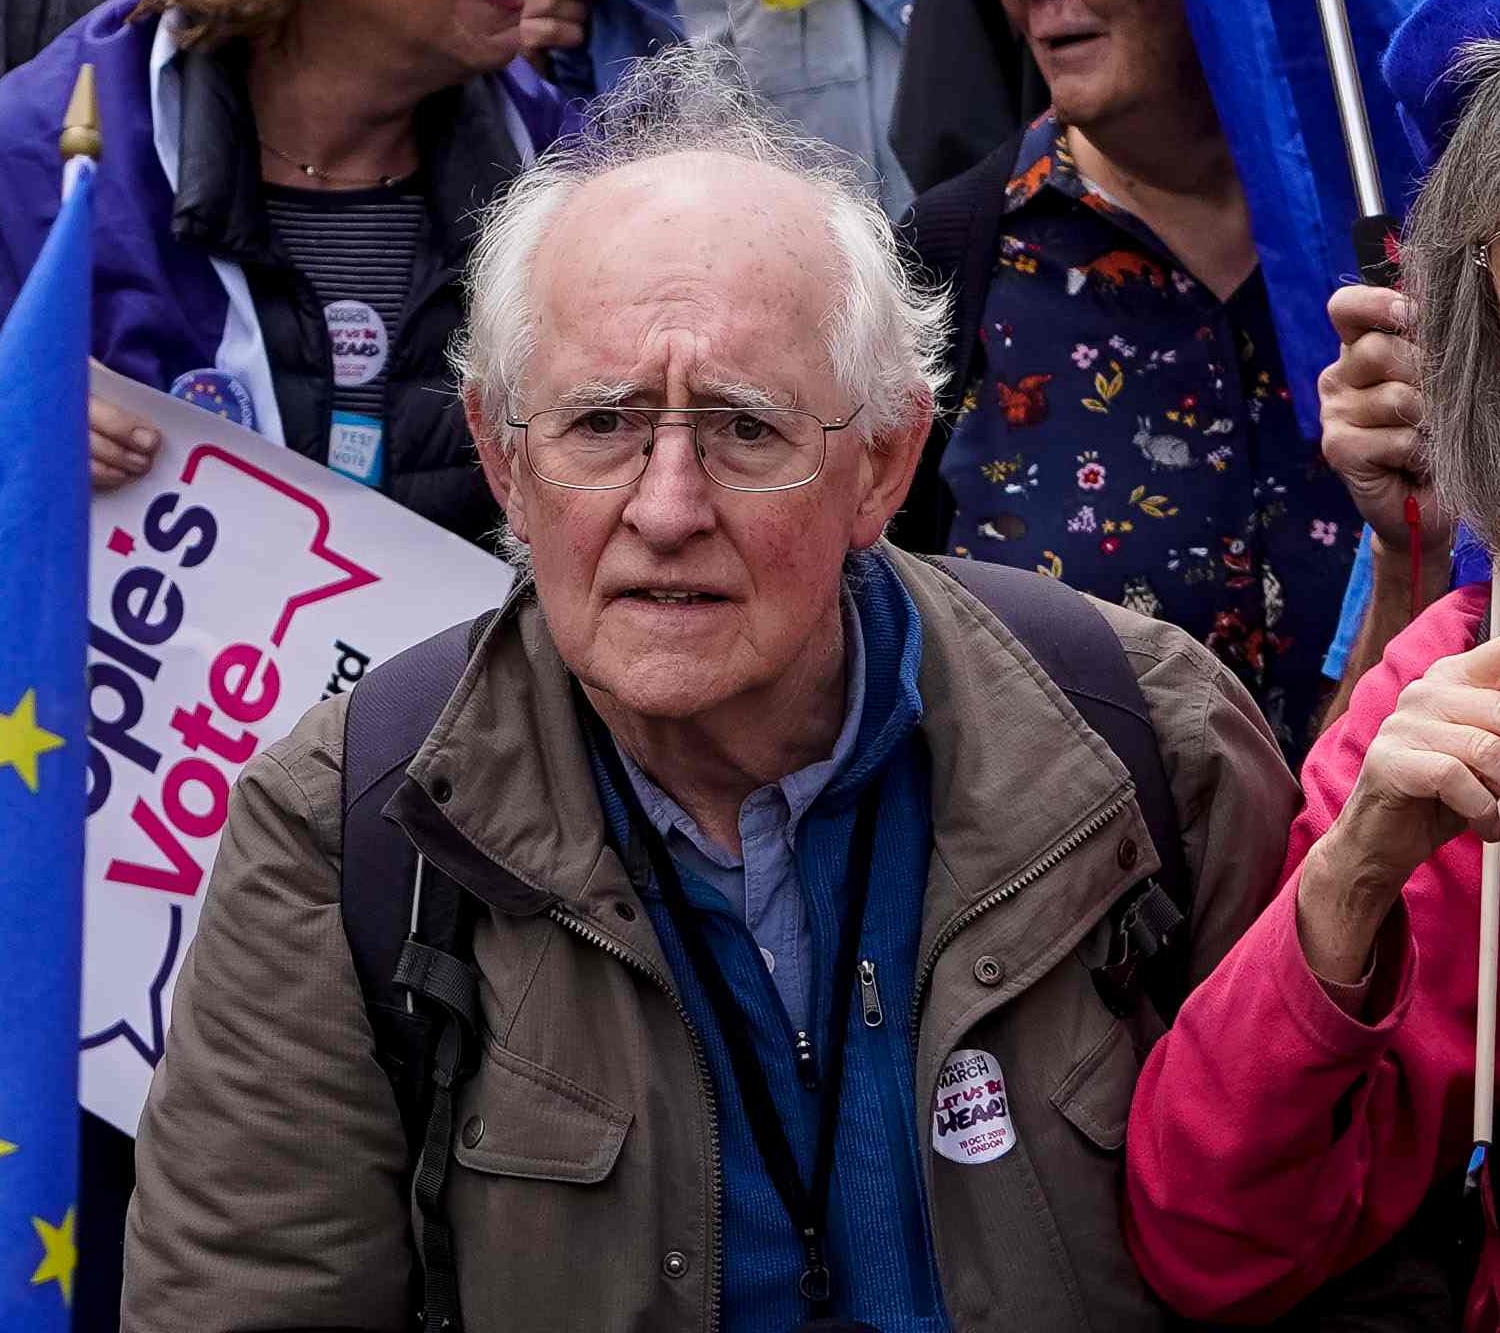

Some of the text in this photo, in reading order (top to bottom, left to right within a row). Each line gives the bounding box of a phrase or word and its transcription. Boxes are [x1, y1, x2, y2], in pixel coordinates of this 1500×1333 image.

[105, 641, 281, 899] Vote
[966, 1138, 1005, 1156] LONDON
[968, 1134, 987, 1147] OCT
